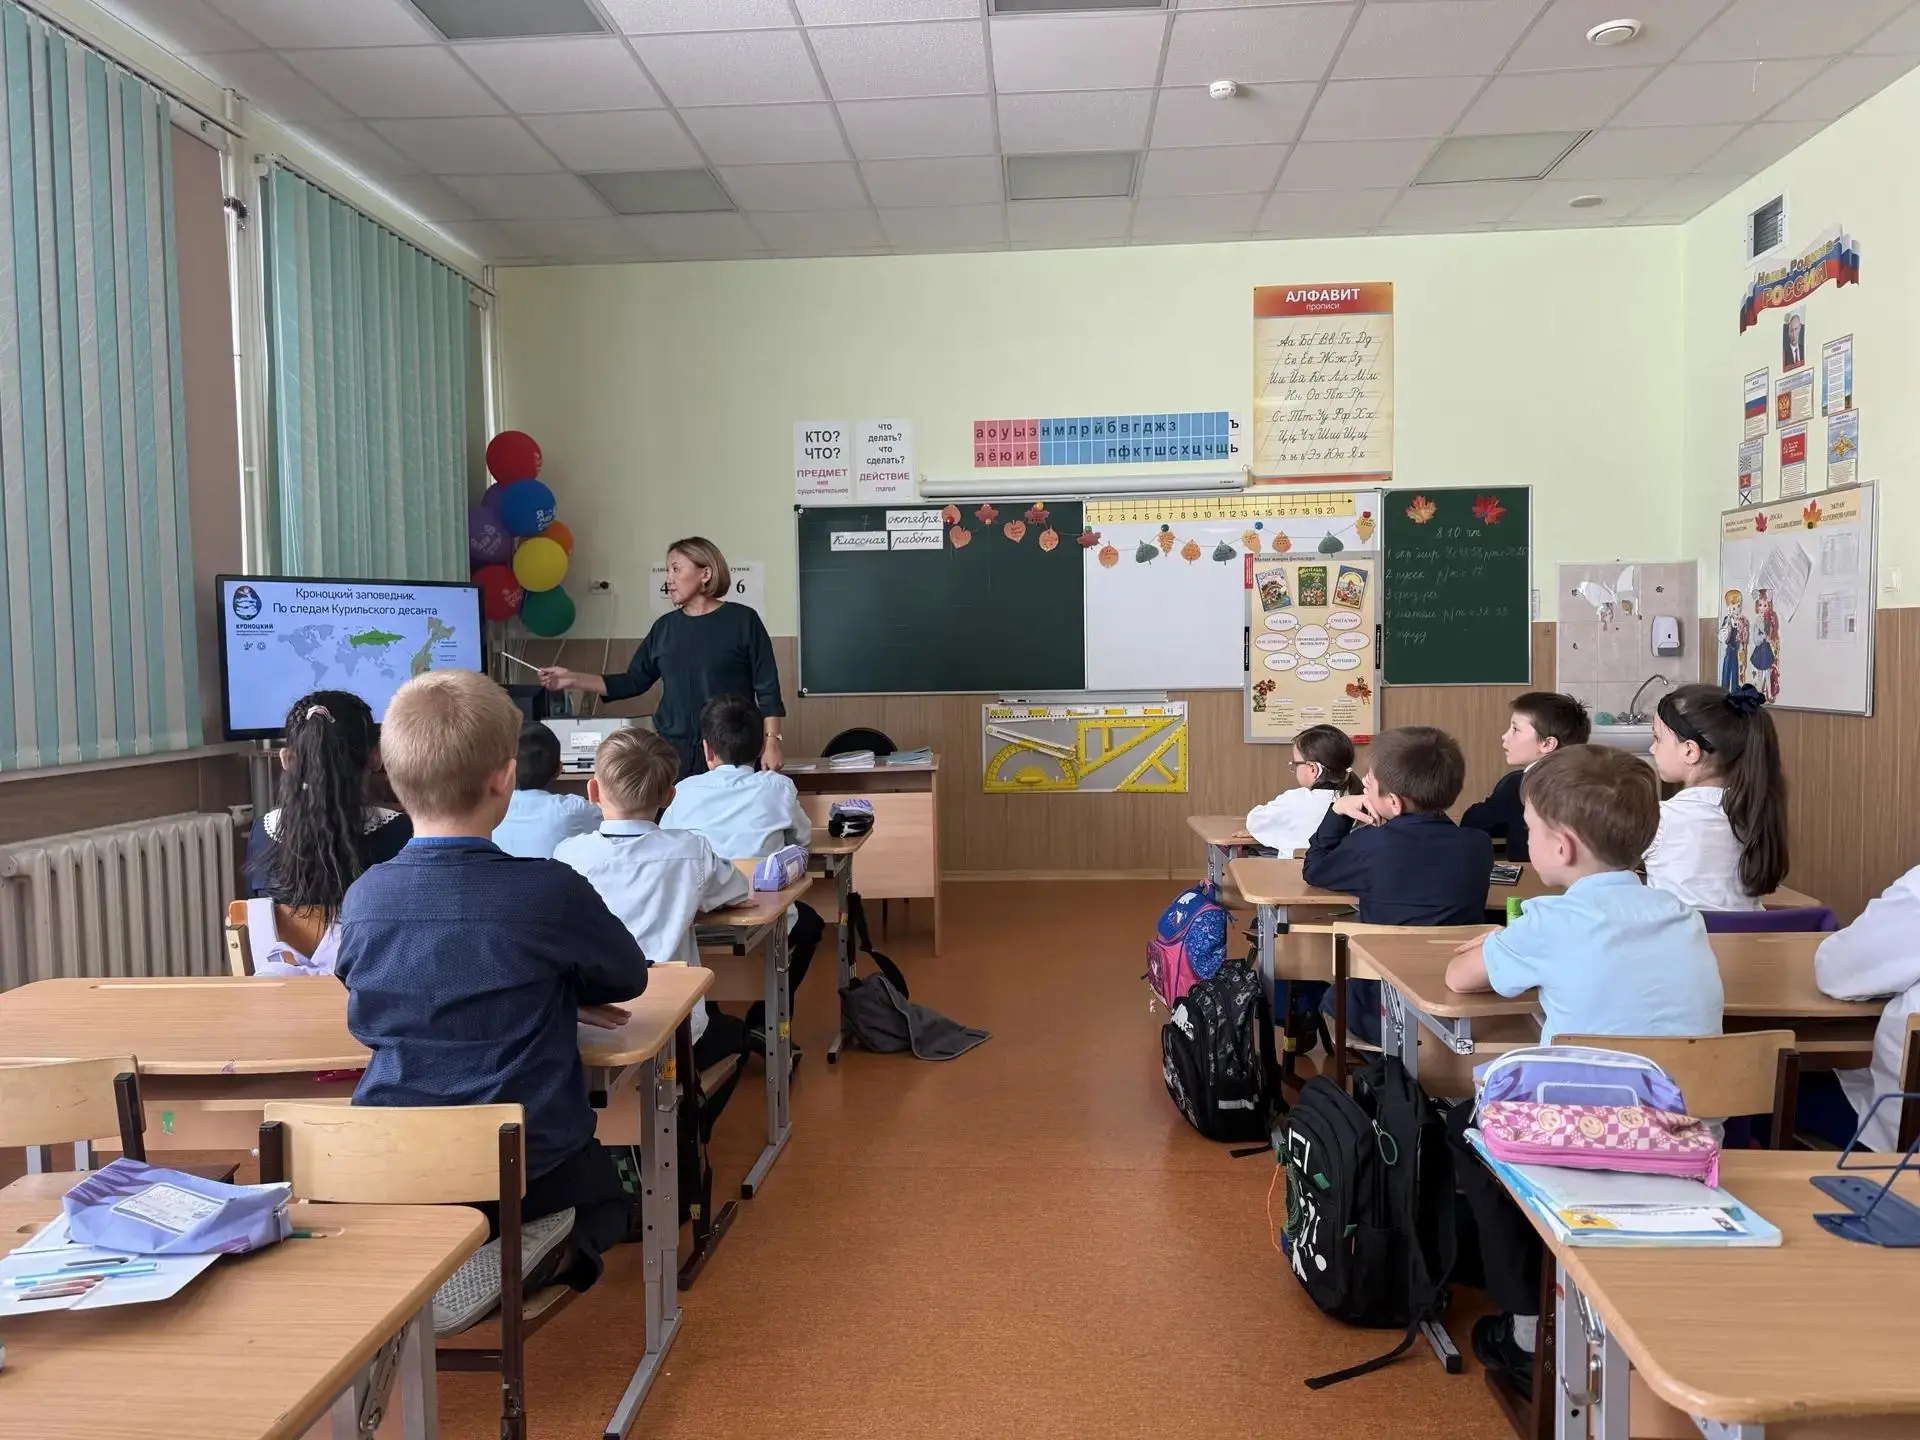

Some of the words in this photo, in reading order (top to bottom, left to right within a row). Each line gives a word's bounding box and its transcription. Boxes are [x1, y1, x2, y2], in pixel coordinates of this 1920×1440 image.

[1285, 288, 1360, 303] АЛФАВИТ
[1306, 303, 1340, 311] прописи
[805, 430, 840, 443] КТО?
[868, 433, 902, 442] делать?
[805, 447, 841, 460] ЧТО?
[866, 456, 905, 465] сделать?
[797, 469, 848, 478] ПРЕДМЕТ
[859, 471, 910, 482] ДЕЙСТВИЕ
[797, 487, 849, 495] существительное
[832, 534, 887, 545] Классная
[660, 581, 669, 595] 4
[736, 578, 745, 594] 6
[296, 588, 353, 600] Кроноцкий
[355, 591, 416, 601] заповедник.
[273, 603, 287, 614] По
[290, 605, 330, 615] следам
[332, 604, 395, 616] Курильского
[398, 607, 438, 616] десанта
[236, 622, 274, 630] КРОНОЦКИЙ
